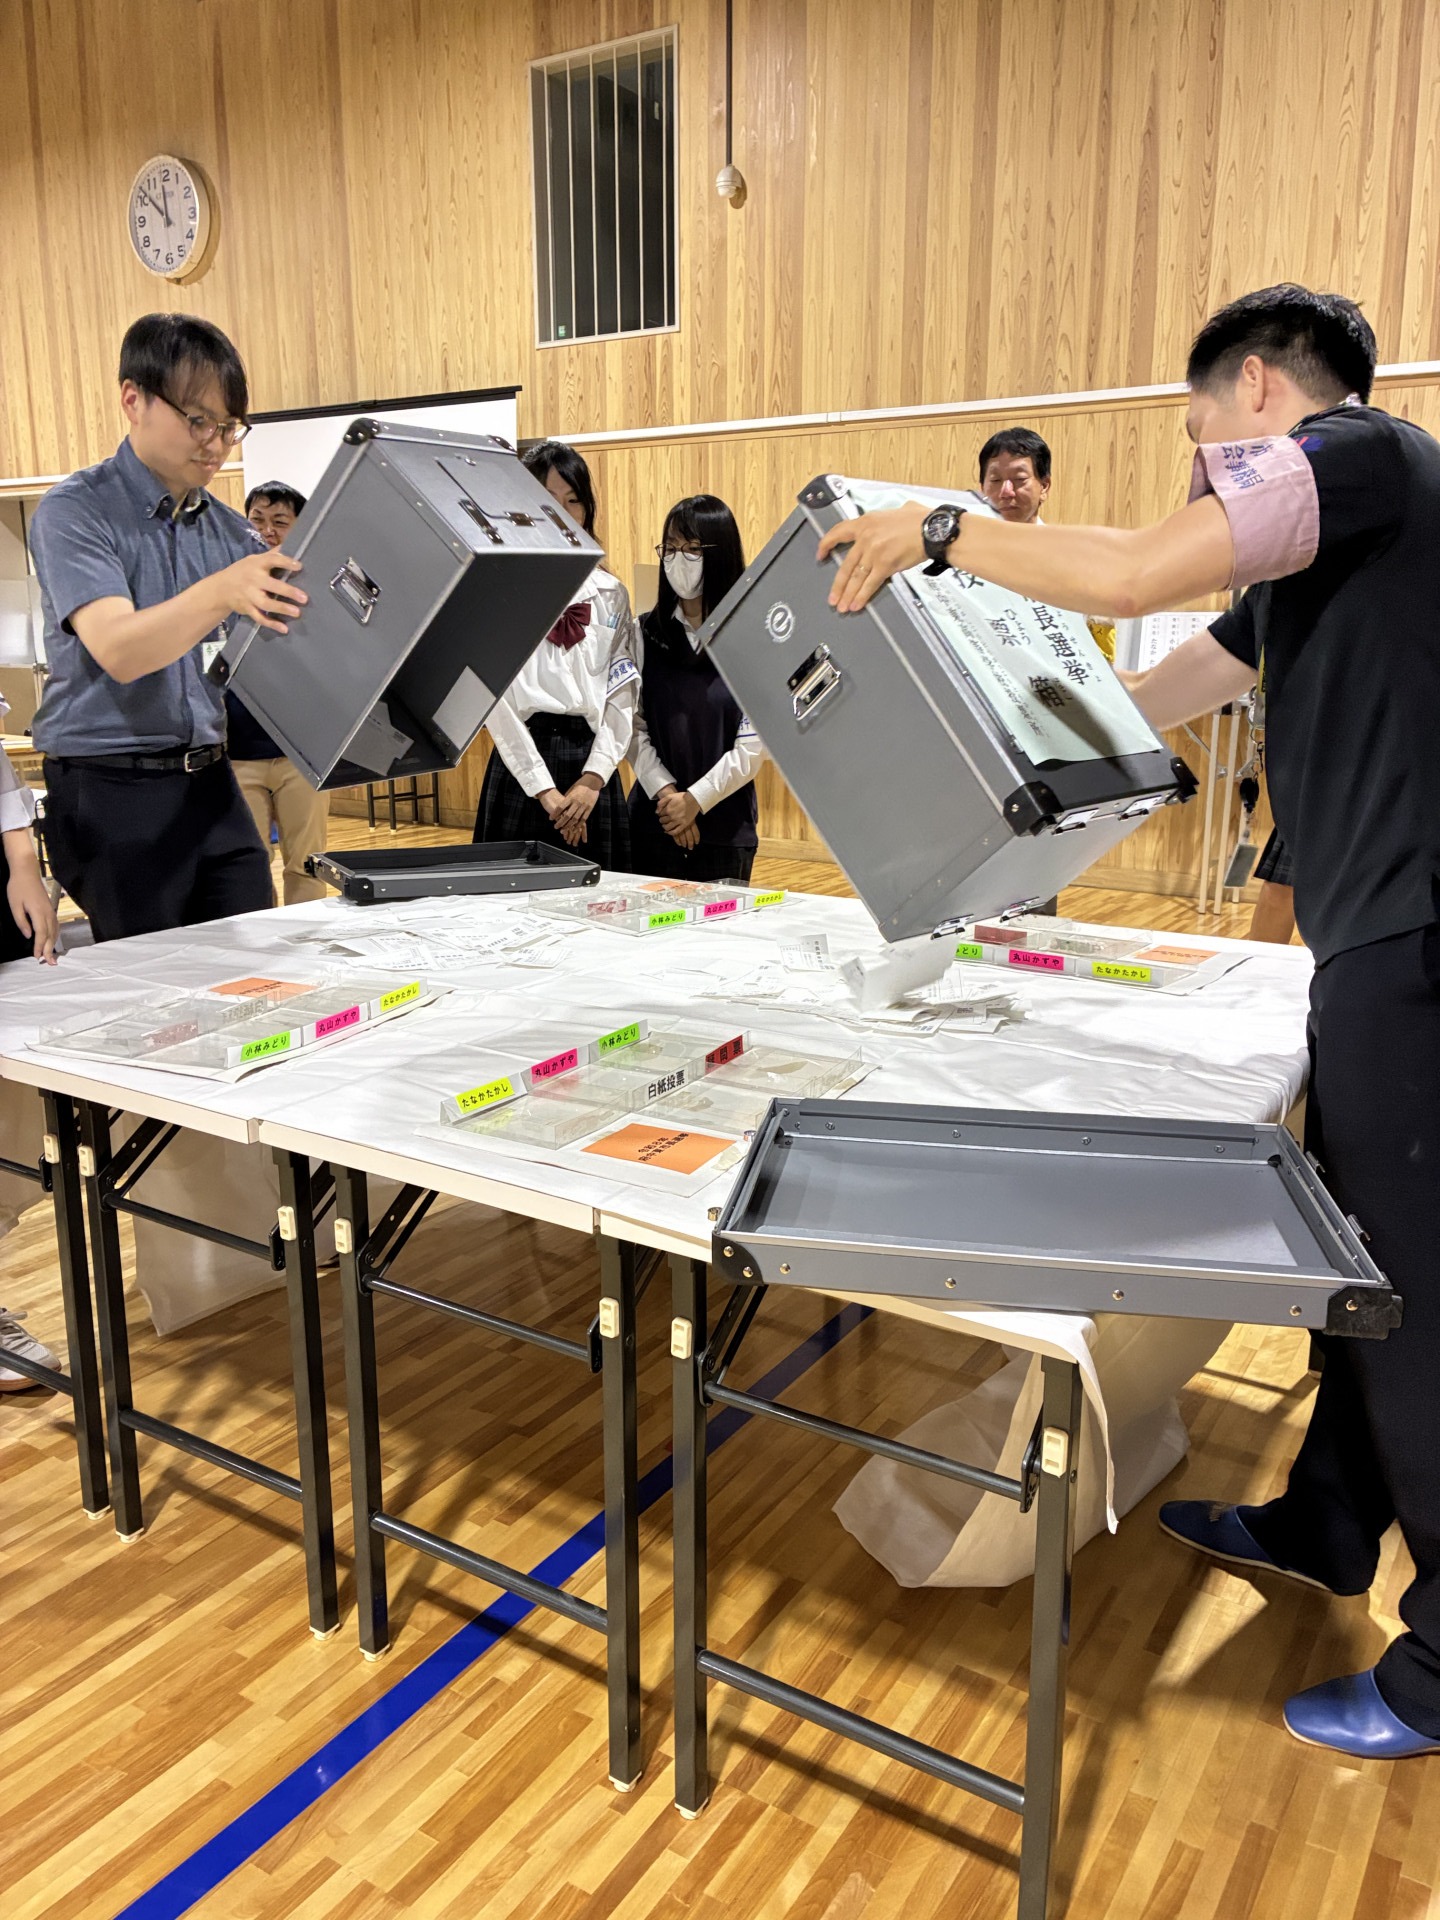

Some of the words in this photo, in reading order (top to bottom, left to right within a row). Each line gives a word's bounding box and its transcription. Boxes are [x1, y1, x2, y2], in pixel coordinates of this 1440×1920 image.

[147, 177, 157, 190] 11
[175, 172, 179, 185] 1
[183, 186, 191, 199] 2
[188, 207, 197, 219] 3
[138, 216, 146, 228] 9
[186, 228, 194, 240] 4
[142, 235, 151, 248] 8
[153, 249, 160, 260] 7
[177, 245, 185, 257] 5
[165, 252, 174, 265] 6
[1023, 597, 1089, 685] 長選挙
[756, 894, 782, 904] たなかたかし
[707, 902, 735, 914] 丸山かずや
[651, 913, 683, 926] 小林みどり
[1013, 952, 1060, 966] 丸山かずや
[1096, 966, 1147, 979] たなかたかし
[383, 987, 417, 1006] たなかたかし
[318, 1011, 357, 1033] 丸山かずや
[601, 1028, 636, 1050] 小林みどり
[245, 1036, 287, 1057] 小林みどり
[535, 1054, 574, 1077] 丸山かずや
[648, 1069, 685, 1099] 白紙投票
[462, 1082, 509, 1108] たなかたかし
